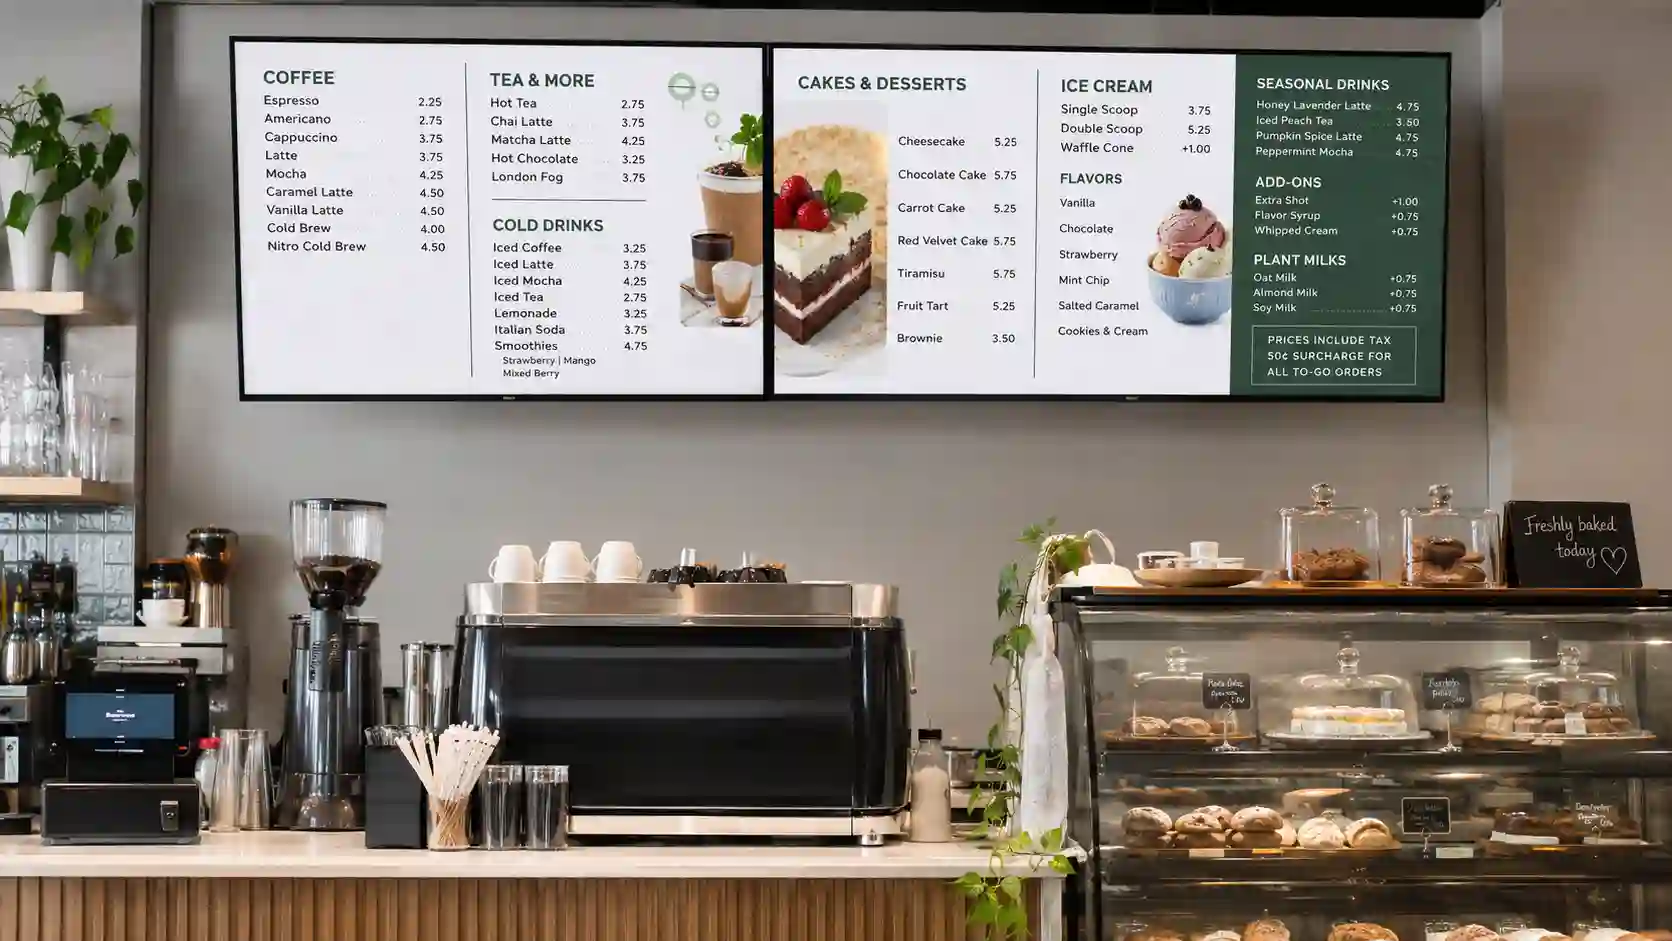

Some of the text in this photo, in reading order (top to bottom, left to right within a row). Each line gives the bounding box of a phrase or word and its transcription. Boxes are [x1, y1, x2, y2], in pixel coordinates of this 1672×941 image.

[263, 70, 335, 85] COFFEE
[489, 72, 595, 88] TEA & MORE
[798, 76, 966, 91] CAKES & DESSERTS
[1062, 79, 1152, 93] ICE CREAM
[1257, 77, 1390, 91] SEASONAL DRINKS
[264, 94, 442, 108] Espresso 2.25
[490, 97, 645, 110] Hot Tea 2.75
[1257, 100, 1420, 112] Honey Lavender Latte 4.75
[1061, 103, 1211, 117] Single Scoop 3.75
[264, 113, 443, 125] Americano 2.75
[490, 116, 645, 128] Chai Latte 3.75
[1256, 115, 1278, 125] Iced
[1281, 115, 1312, 125] Peach
[1315, 116, 1333, 126] Tea
[1061, 123, 1211, 136] Double Scoop 5.25
[264, 131, 443, 145] Cappuccino 3.75
[491, 134, 645, 146] Matcha Latte 4.25
[898, 136, 1017, 147] Cheesecake 5.25
[1256, 131, 1419, 142] Pumpkin Spice Latte 4.75
[1060, 142, 1211, 154] Waffle Cone +1.00
[1256, 146, 1418, 158] Peppermint Mocha 4.75
[265, 150, 443, 162] Latte 3.75
[491, 153, 645, 164] Hot Chocolate 3.25
[266, 168, 444, 180] Mocha 4.25
[492, 171, 646, 185] London Fog 3.75
[898, 169, 1017, 180] Chocolate Cake 5.75
[1060, 173, 1122, 184] FLAVORS
[1255, 176, 1322, 188] ADD-ONS
[266, 186, 444, 198] Caramel Latte 4.50
[1059, 198, 1095, 208] Vanilla
[1255, 195, 1419, 206] Extra Shot +1.00
[266, 204, 445, 216] Vanilla Latte 4.50
[897, 202, 1017, 214] Carrot Cake 5.25
[1255, 210, 1419, 222] Flavor Syrup +0.75
[267, 222, 445, 234] Cold Brew 4.00
[493, 218, 604, 232] COLD DRINKS
[1059, 223, 1114, 234] Chocolate
[1254, 225, 1419, 237] Whipped Cream +0.75
[268, 240, 446, 252] Nitro Cold Brew 4.50
[898, 235, 1016, 246] Red Velvet Cake 5.75
[493, 242, 646, 253] Iced Coffee 3.25
[1059, 249, 1118, 262] Strawberry
[1254, 254, 1346, 266] PLANT MILKS
[493, 259, 647, 270] Iced Latte 3.75
[897, 268, 1016, 279] Tiramisu 5.75
[1253, 272, 1417, 283] Oat Milk +0.75
[494, 275, 647, 286] Iced Mocha 4.25
[1059, 275, 1110, 287] Mint Chip
[494, 291, 647, 302] Iced Tea 2.75
[1252, 288, 1417, 298] Almond Milk +0.75
[897, 301, 1016, 311] Fruit Tart 5.25
[1058, 300, 1139, 311] Salted Caramel
[1253, 303, 1417, 314] Soy Milk +0.75
[494, 307, 647, 319] Lemonade 3.25
[494, 324, 648, 335] Italian Soda 3.75
[1058, 326, 1148, 336] Cookies & Cream
[897, 333, 1016, 343] Brownie 3.50
[1268, 335, 1391, 345] PRICES INCLUDE TAX
[494, 340, 648, 351] Smoothies 4.75
[503, 356, 555, 366] Strawberry
[563, 356, 596, 367] Mango
[1267, 351, 1391, 361] 50¢ SURCHARGE FOR
[503, 369, 560, 379] Mixed Berry
[1267, 367, 1382, 377] ALL TO-GO ORDERS
[1523, 514, 1618, 541] Freshly baked
[1554, 542, 1597, 569] today
